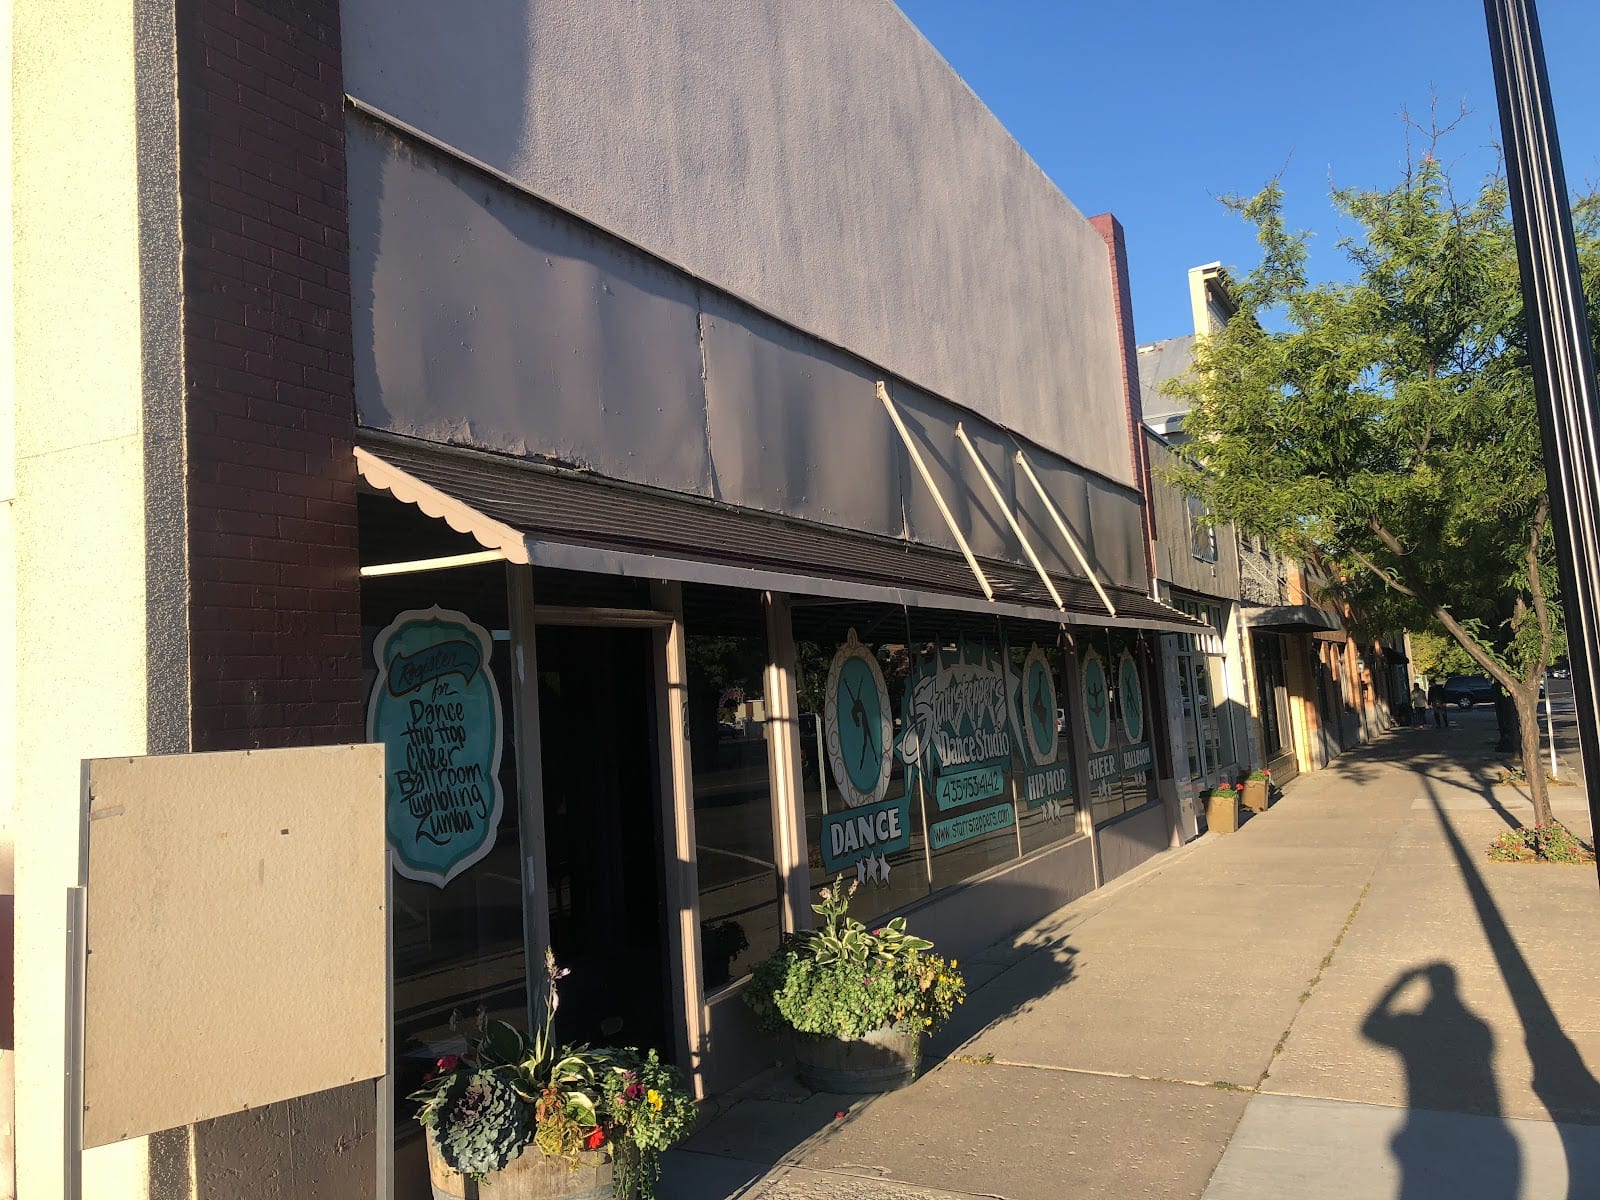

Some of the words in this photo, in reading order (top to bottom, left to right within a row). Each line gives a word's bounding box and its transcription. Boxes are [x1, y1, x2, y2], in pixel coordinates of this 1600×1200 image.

[397, 652, 473, 693] Register
[431, 675, 459, 703] for
[408, 698, 465, 725] Dance
[406, 742, 461, 775] Cheer
[940, 730, 977, 768] Dance
[975, 720, 1010, 761] Studio
[1123, 747, 1151, 770] BALLROOM
[394, 763, 485, 796] Ballroom
[1087, 754, 1117, 781] CHEER
[1027, 773, 1046, 801] HIP
[1046, 768, 1067, 796] HOP
[400, 784, 488, 820] Tumbling
[415, 808, 474, 847] Zumba
[829, 807, 902, 857] DANCE
